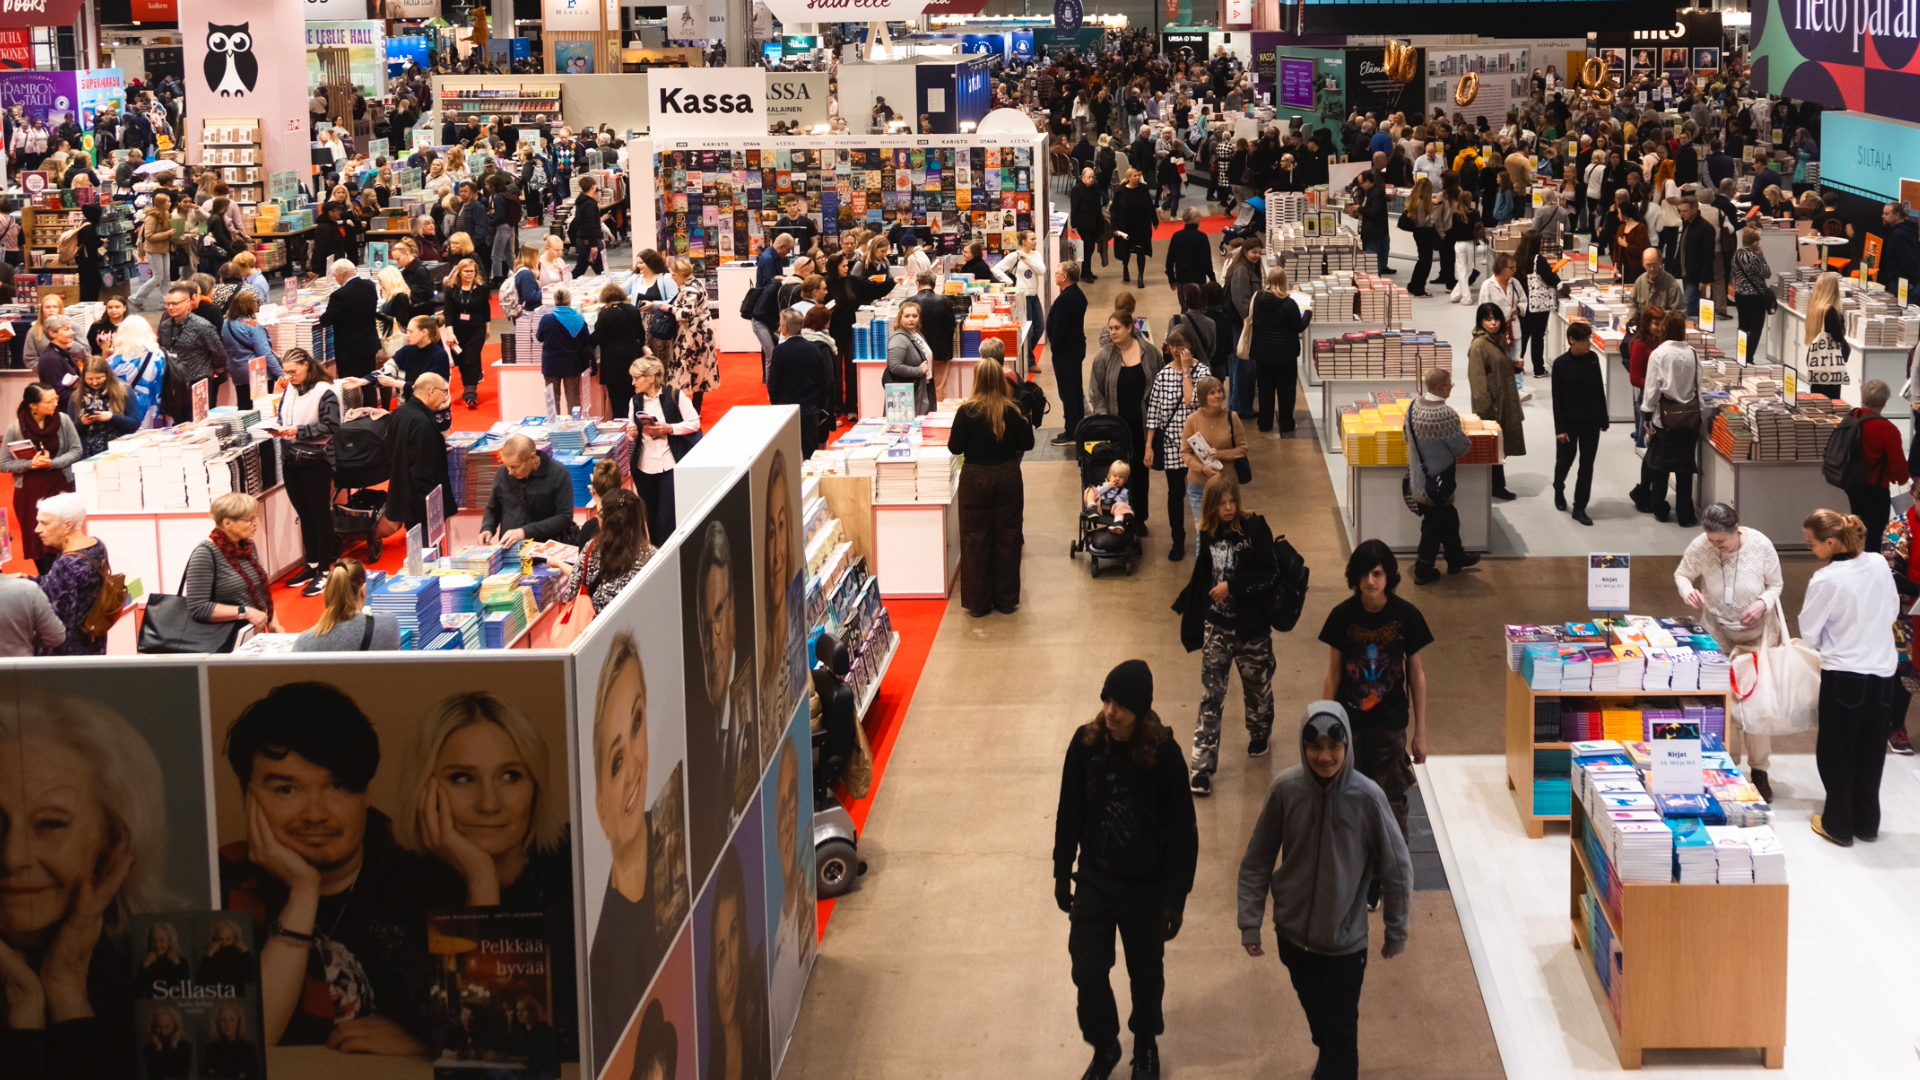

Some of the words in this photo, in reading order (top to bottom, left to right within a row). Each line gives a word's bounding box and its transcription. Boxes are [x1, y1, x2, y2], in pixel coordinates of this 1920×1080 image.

[316, 29, 345, 44] LESLIE
[350, 29, 373, 44] HALL
[766, 83, 811, 100] SSA
[660, 87, 754, 114] Kassa
[1857, 146, 1893, 172] SILTALA
[1668, 751, 1687, 759] Kirjat
[481, 938, 543, 954] Pelkkää
[496, 960, 544, 978] hyvää
[153, 979, 236, 1000] Sellasta
